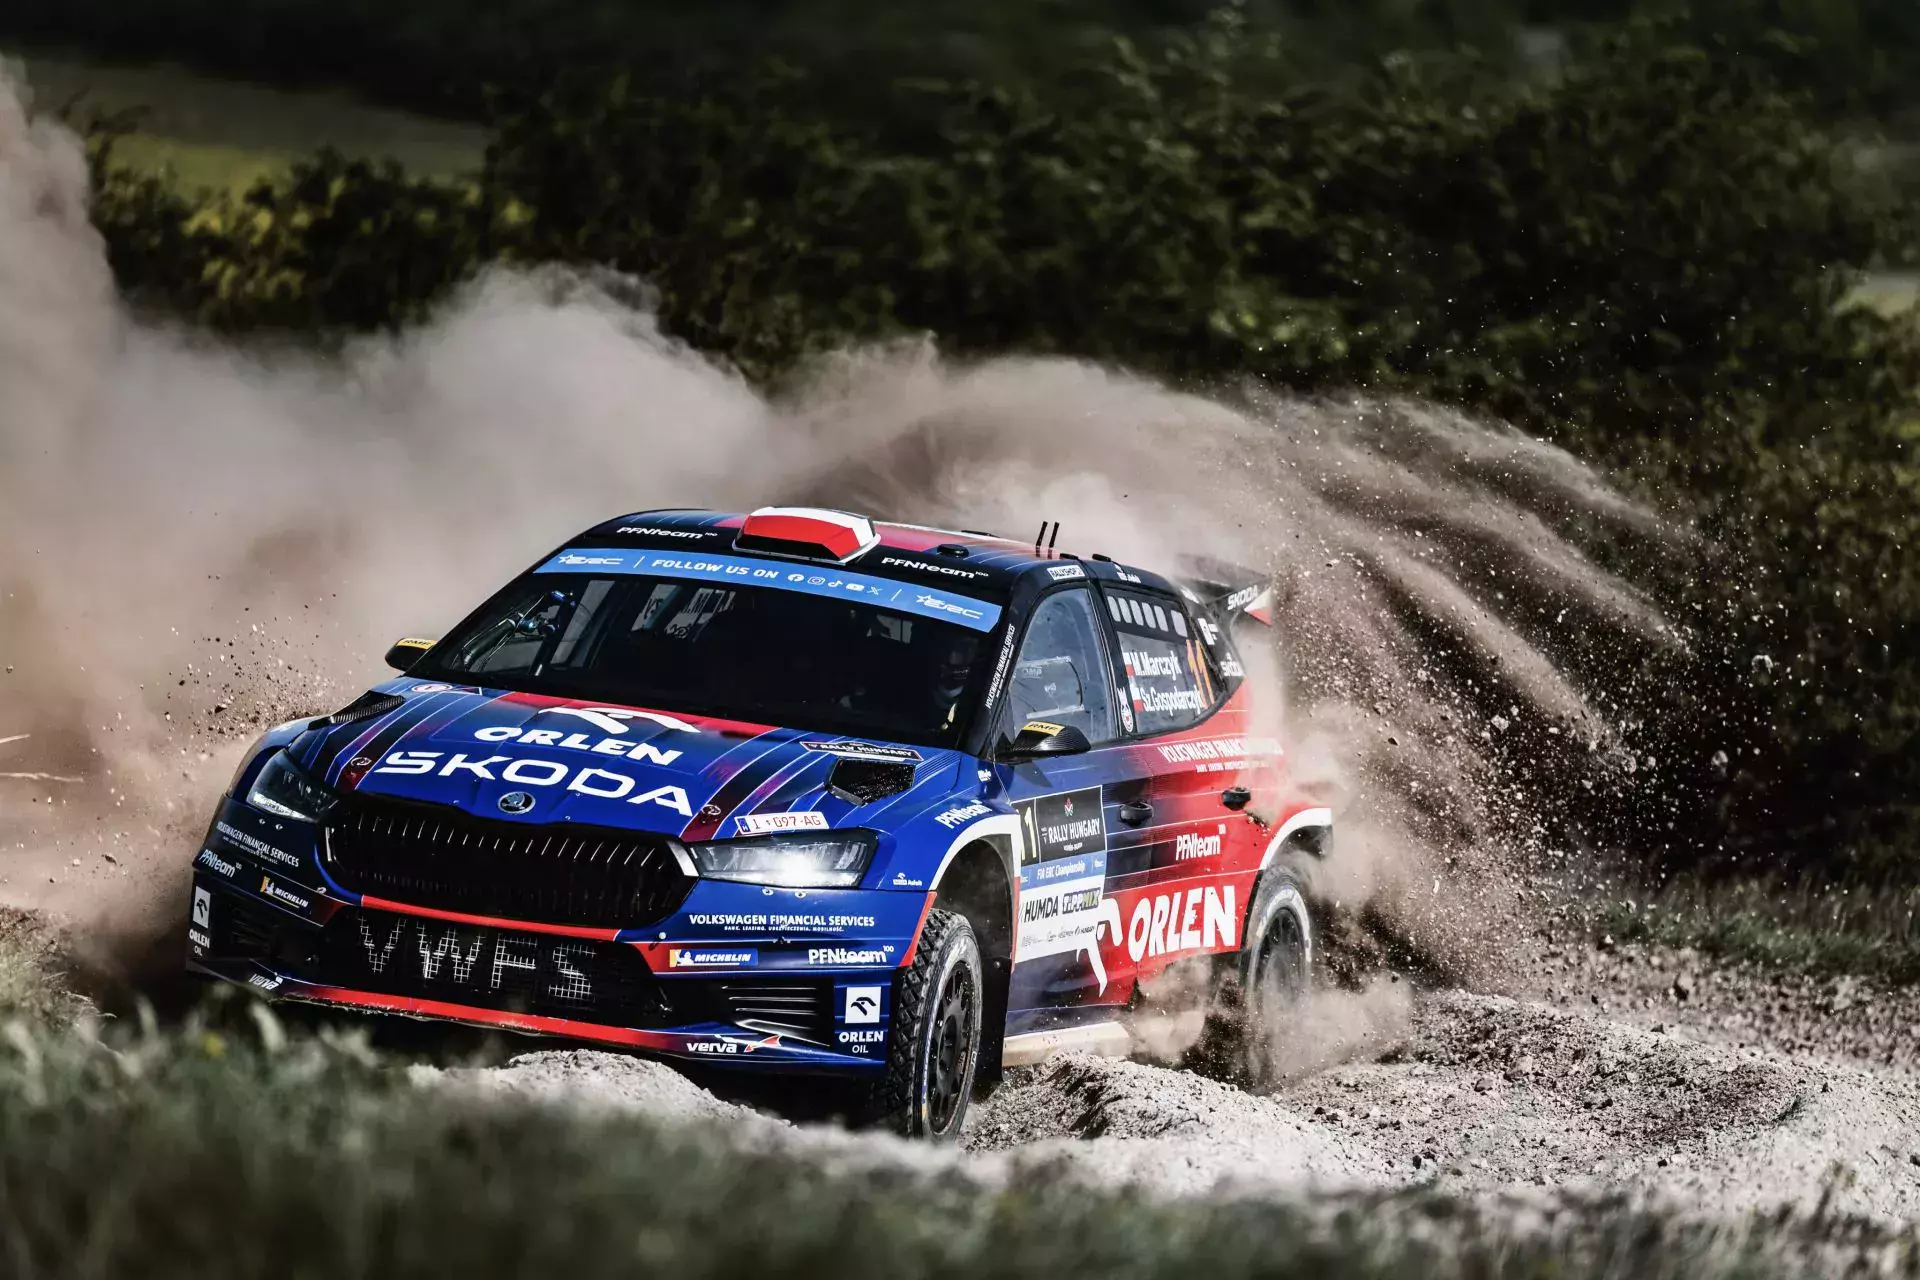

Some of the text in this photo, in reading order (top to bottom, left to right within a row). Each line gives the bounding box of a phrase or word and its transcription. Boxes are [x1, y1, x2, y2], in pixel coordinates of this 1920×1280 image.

[616, 526, 703, 540] PFNteam
[652, 559, 780, 580] FOLLOW US ON
[881, 557, 975, 579] PFNteam
[984, 669, 1001, 710] VOLKSWAGEN
[996, 645, 1010, 674] FINANCIAL
[1004, 623, 1016, 648] SERVICES
[474, 726, 684, 767] ORLEN
[1157, 740, 1220, 763] VOLKSWAGEN
[1048, 823, 1069, 844] RALLY
[1069, 818, 1101, 840] HUNGARY
[243, 834, 271, 855] FINANCIAL
[270, 847, 300, 868] SERVICES
[1175, 832, 1221, 861] PFNteam
[199, 849, 236, 878] PFNteam
[274, 887, 309, 908] MICHELIN
[1024, 895, 1059, 923] HUMDA
[689, 914, 875, 927] VOLKSWAGEN FINANCIAL SERVICES
[1128, 884, 1236, 962] ORLEN
[189, 928, 210, 949] ORLEN
[694, 953, 752, 963] MICHELIN
[807, 949, 887, 964] PFNteam
[838, 1031, 884, 1043] ORLEN
[687, 1042, 737, 1054] verva
[851, 1045, 869, 1054] OIL
